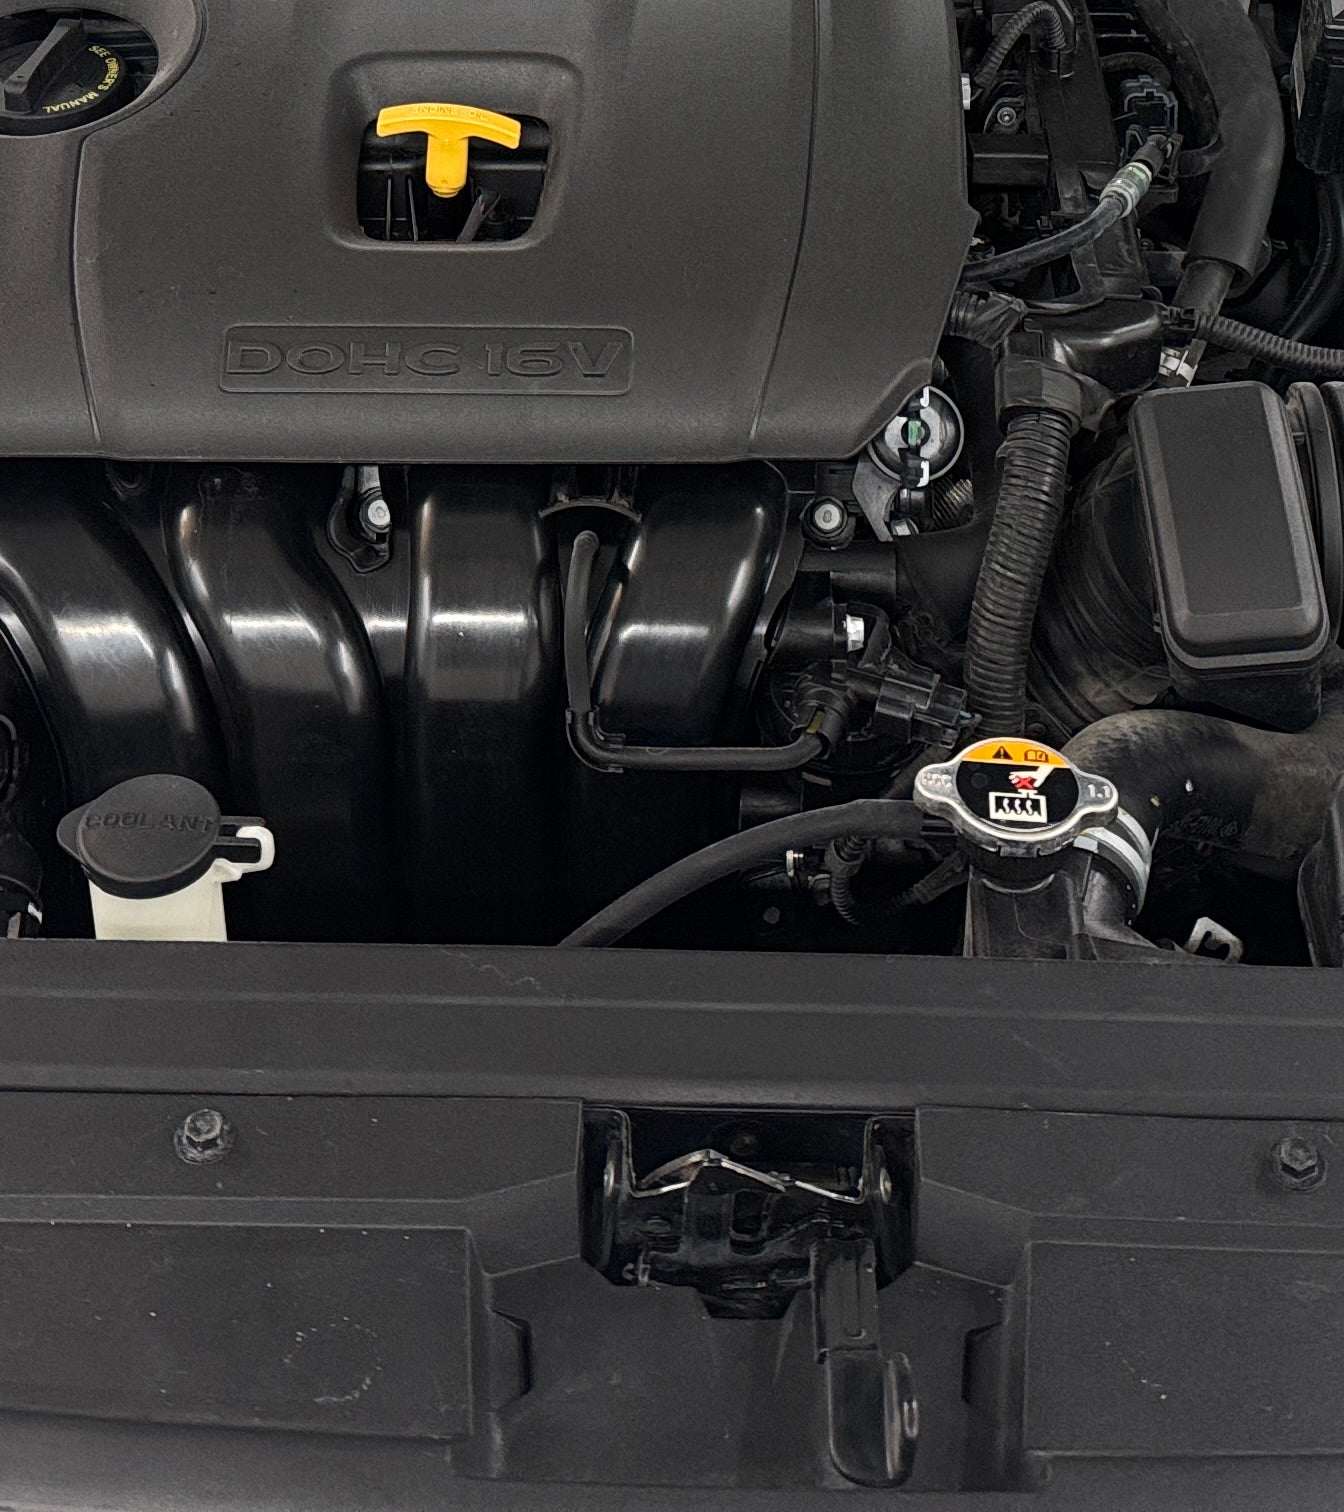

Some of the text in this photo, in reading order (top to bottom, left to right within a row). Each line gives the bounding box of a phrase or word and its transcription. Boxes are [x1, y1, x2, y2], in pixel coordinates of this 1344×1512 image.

[88, 44, 111, 59] SEE
[42, 90, 101, 114] MANUAL
[225, 339, 624, 379] DOHC 16V
[1087, 783, 1112, 800] 1.1
[85, 811, 214, 834] COOLANT
